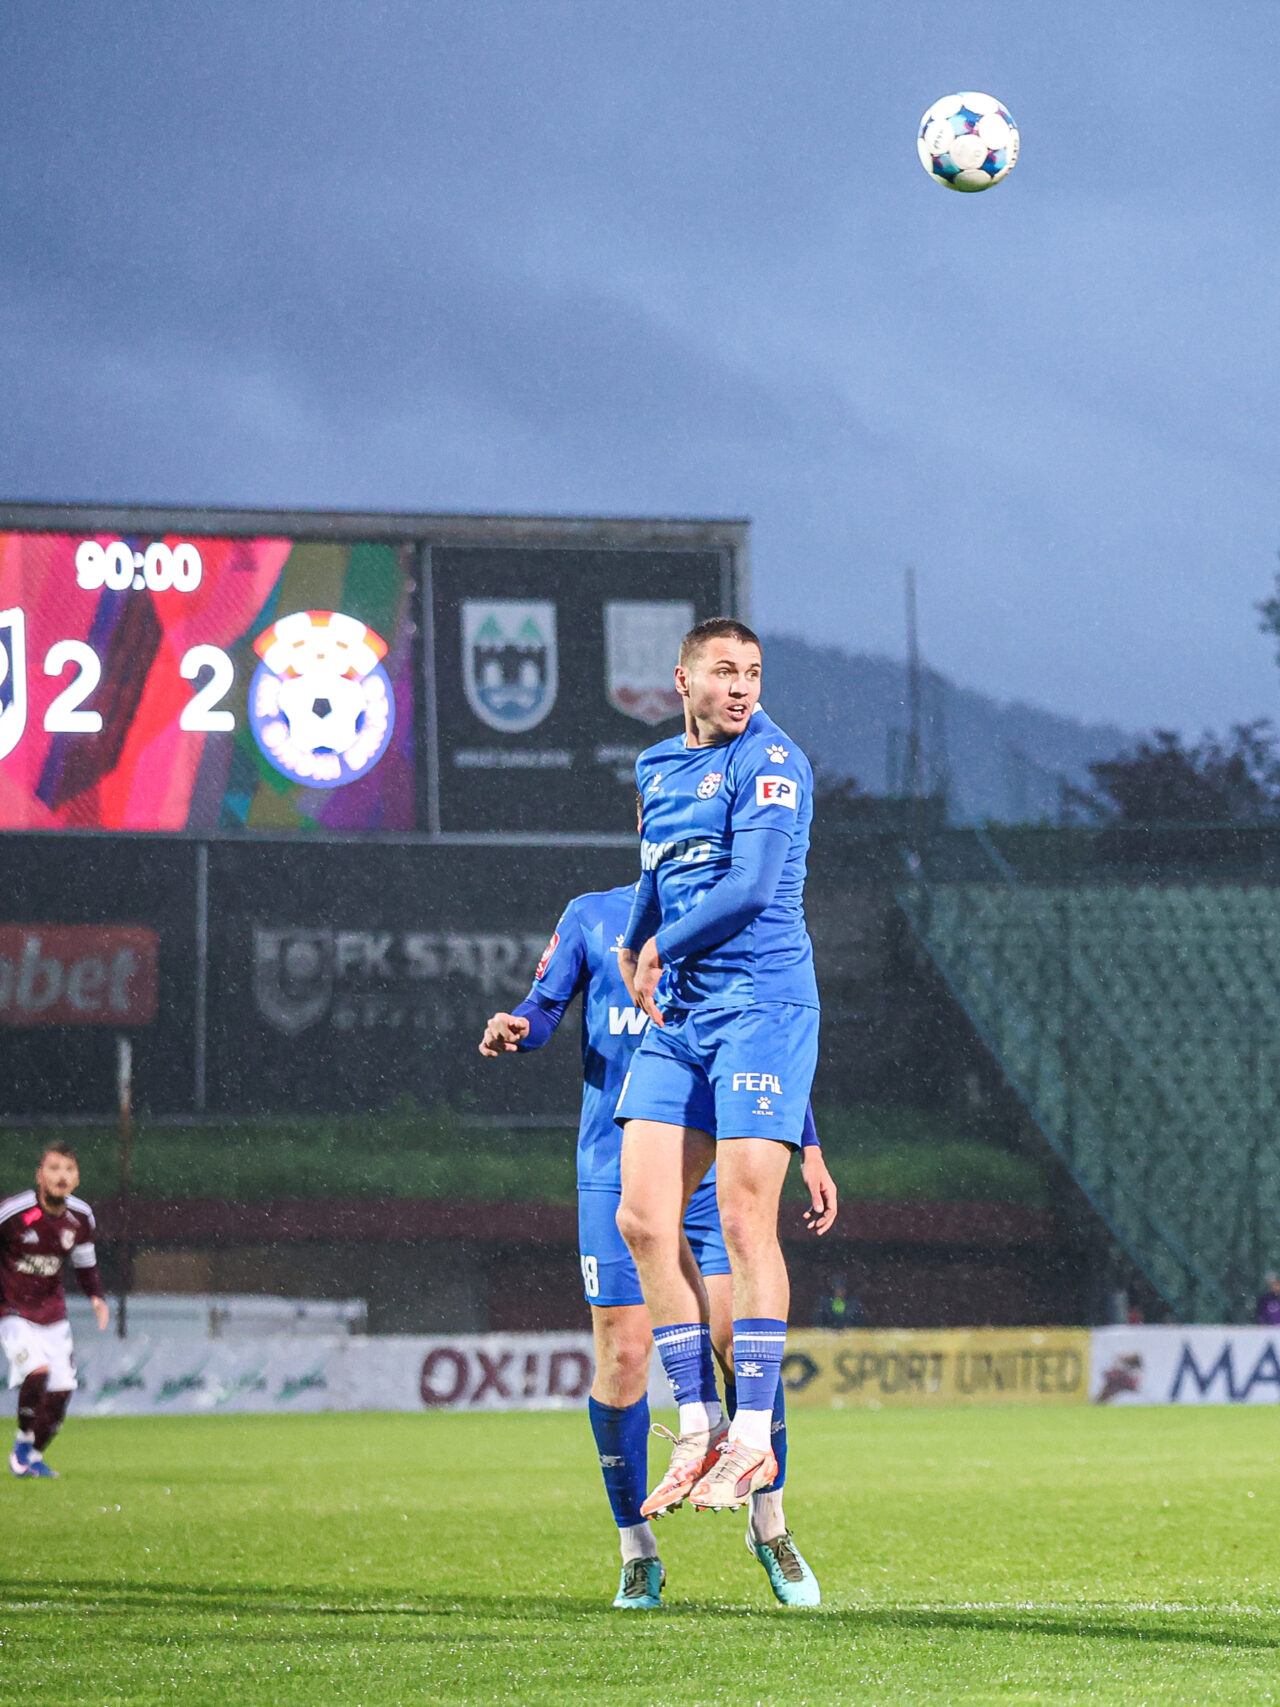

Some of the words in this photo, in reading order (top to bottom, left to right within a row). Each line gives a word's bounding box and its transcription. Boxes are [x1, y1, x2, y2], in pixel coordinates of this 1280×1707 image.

[75, 540, 203, 592] 90:00
[43, 639, 103, 733] 2
[179, 643, 236, 732] 2
[335, 931, 393, 979] FK
[732, 1072, 783, 1095] FEAL
[833, 1349, 943, 1394] SPORT
[952, 1349, 1084, 1394] UNITED
